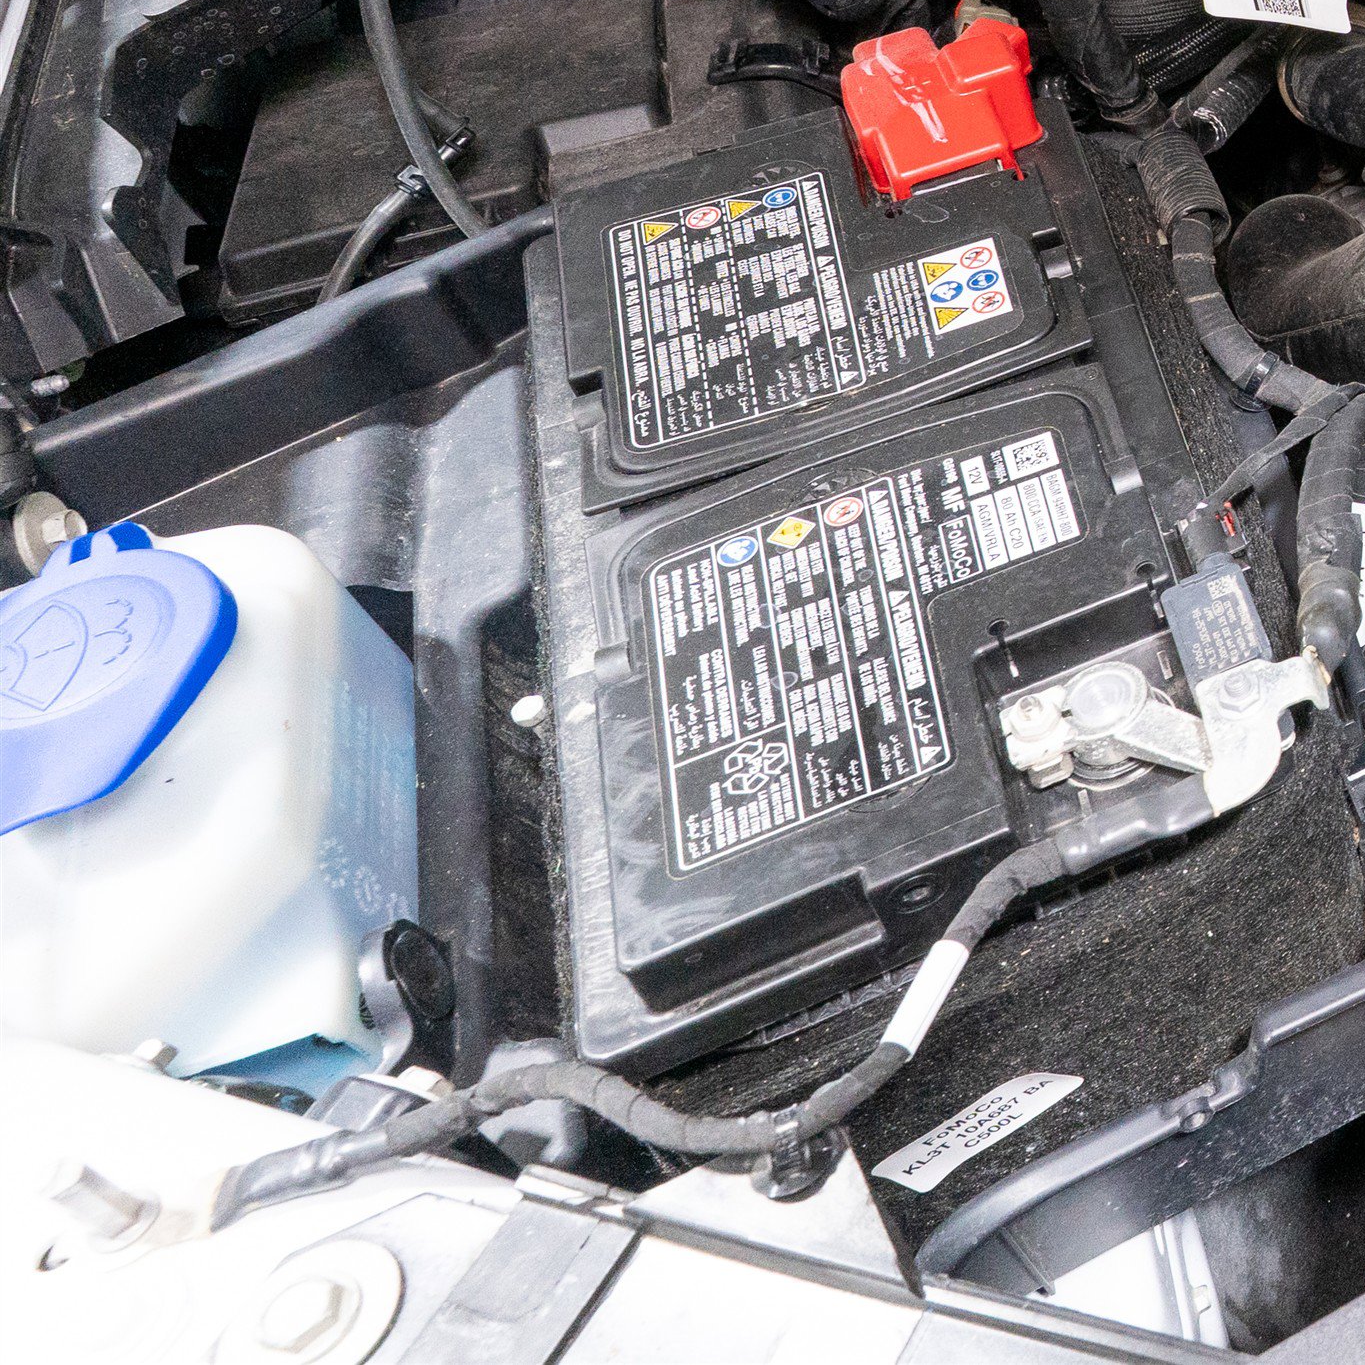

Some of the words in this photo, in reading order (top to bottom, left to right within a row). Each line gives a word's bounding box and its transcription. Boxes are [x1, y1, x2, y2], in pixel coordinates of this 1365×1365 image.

[818, 263, 847, 330] PELIGRO/VENENO
[629, 337, 644, 351] NO
[631, 349, 645, 363] LA
[966, 466, 983, 486] 12V
[1022, 482, 1037, 499] 800
[938, 485, 967, 515] MF
[1000, 495, 1014, 510] 80
[1026, 498, 1042, 516] CCA
[972, 502, 1004, 561] AGM/VRLA
[1004, 511, 1018, 526] Ah
[940, 518, 978, 579] FoMoCo
[1007, 526, 1025, 549] C20
[890, 600, 927, 691] PELIGRO/VENENO
[709, 647, 726, 688] CONTRA
[902, 1144, 952, 1176] KL3T
[955, 1096, 1020, 1139] 10A687
[1023, 1079, 1054, 1095] BA
[922, 1096, 1003, 1147] FoMoCo
[963, 1112, 1023, 1149] C500L
